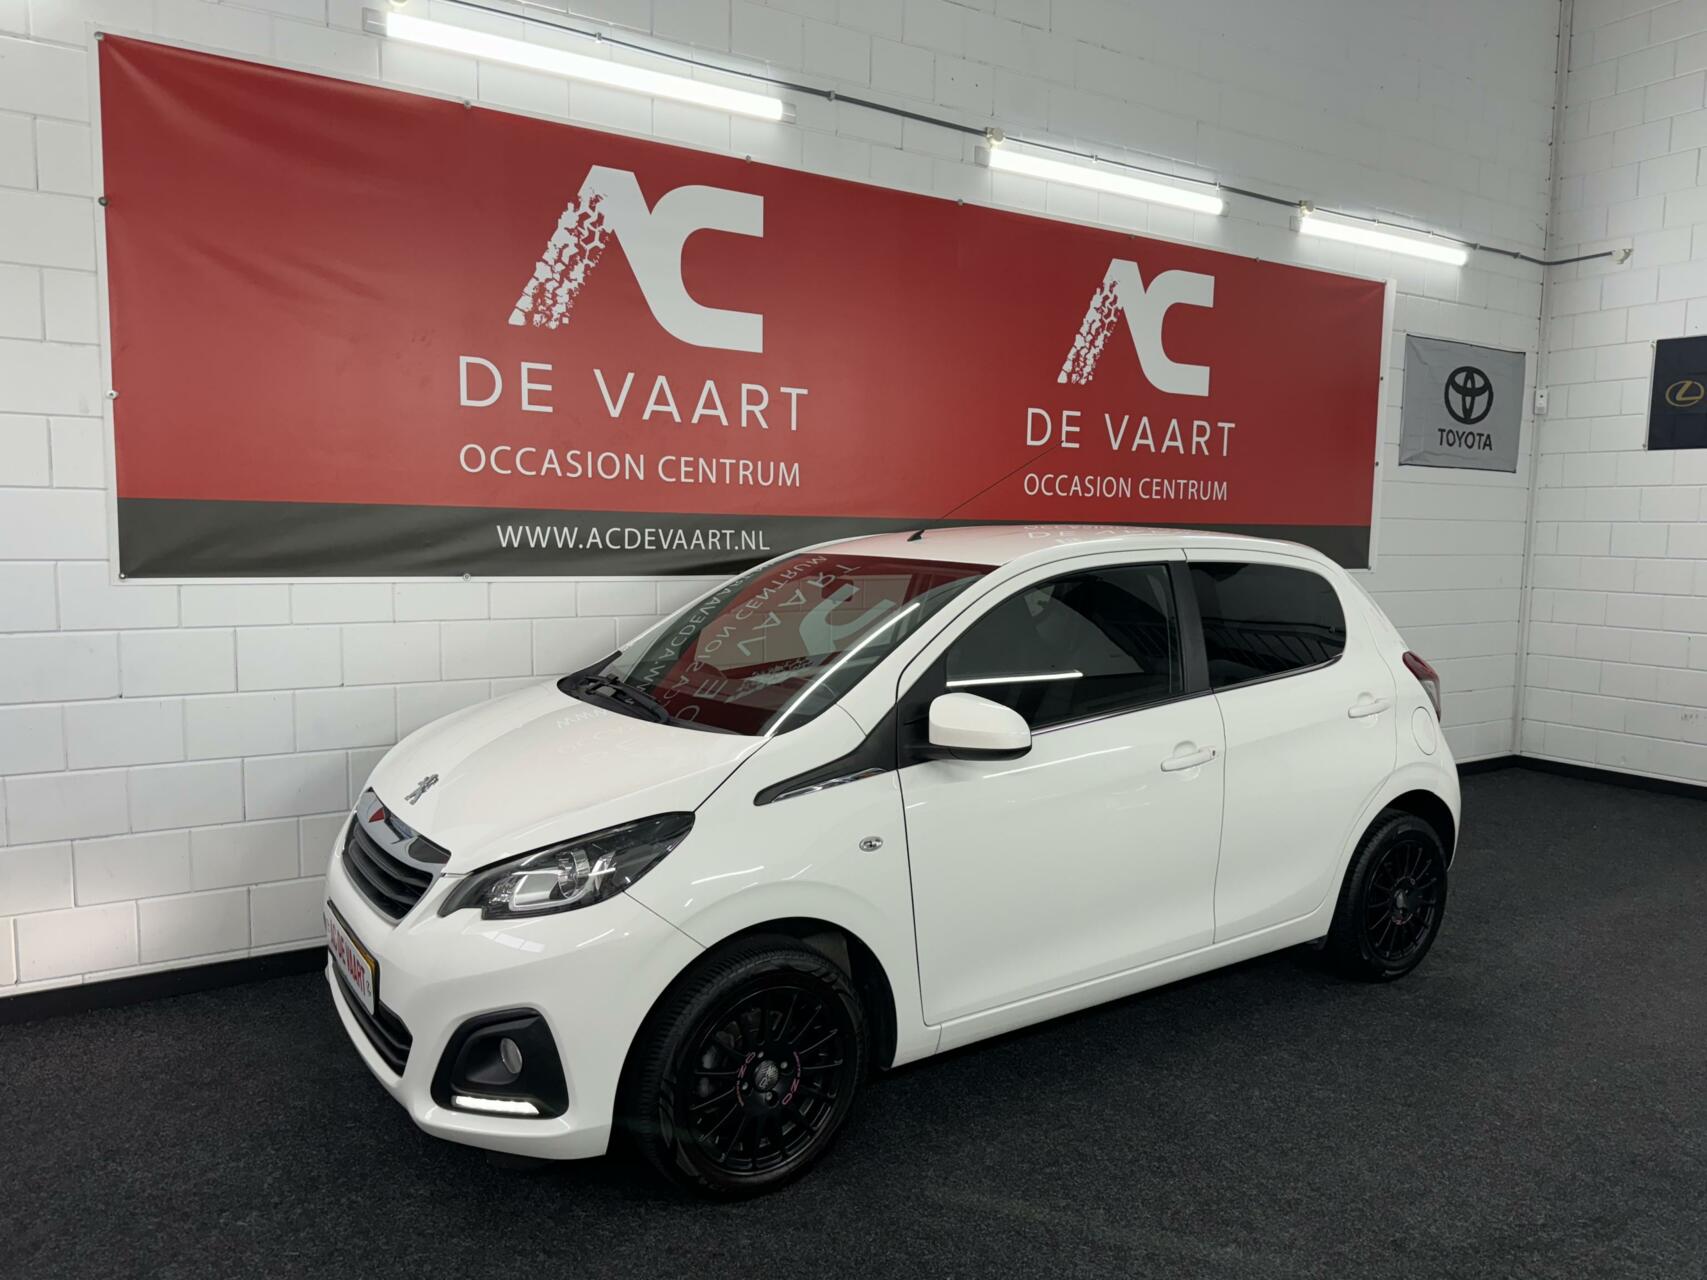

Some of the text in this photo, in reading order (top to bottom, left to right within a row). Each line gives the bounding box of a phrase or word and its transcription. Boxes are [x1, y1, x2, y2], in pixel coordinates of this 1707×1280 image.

[508, 164, 764, 353] AC
[1057, 258, 1215, 397] AC
[459, 355, 809, 431] DE VAART
[1026, 407, 1236, 457] DE VAART
[1437, 428, 1493, 451] TOYOTA
[459, 443, 801, 487] OCCASION CENTRUM
[1023, 473, 1228, 501] OCCASION CENTRUM
[496, 525, 771, 551] WWW.ACDEVAART.NL
